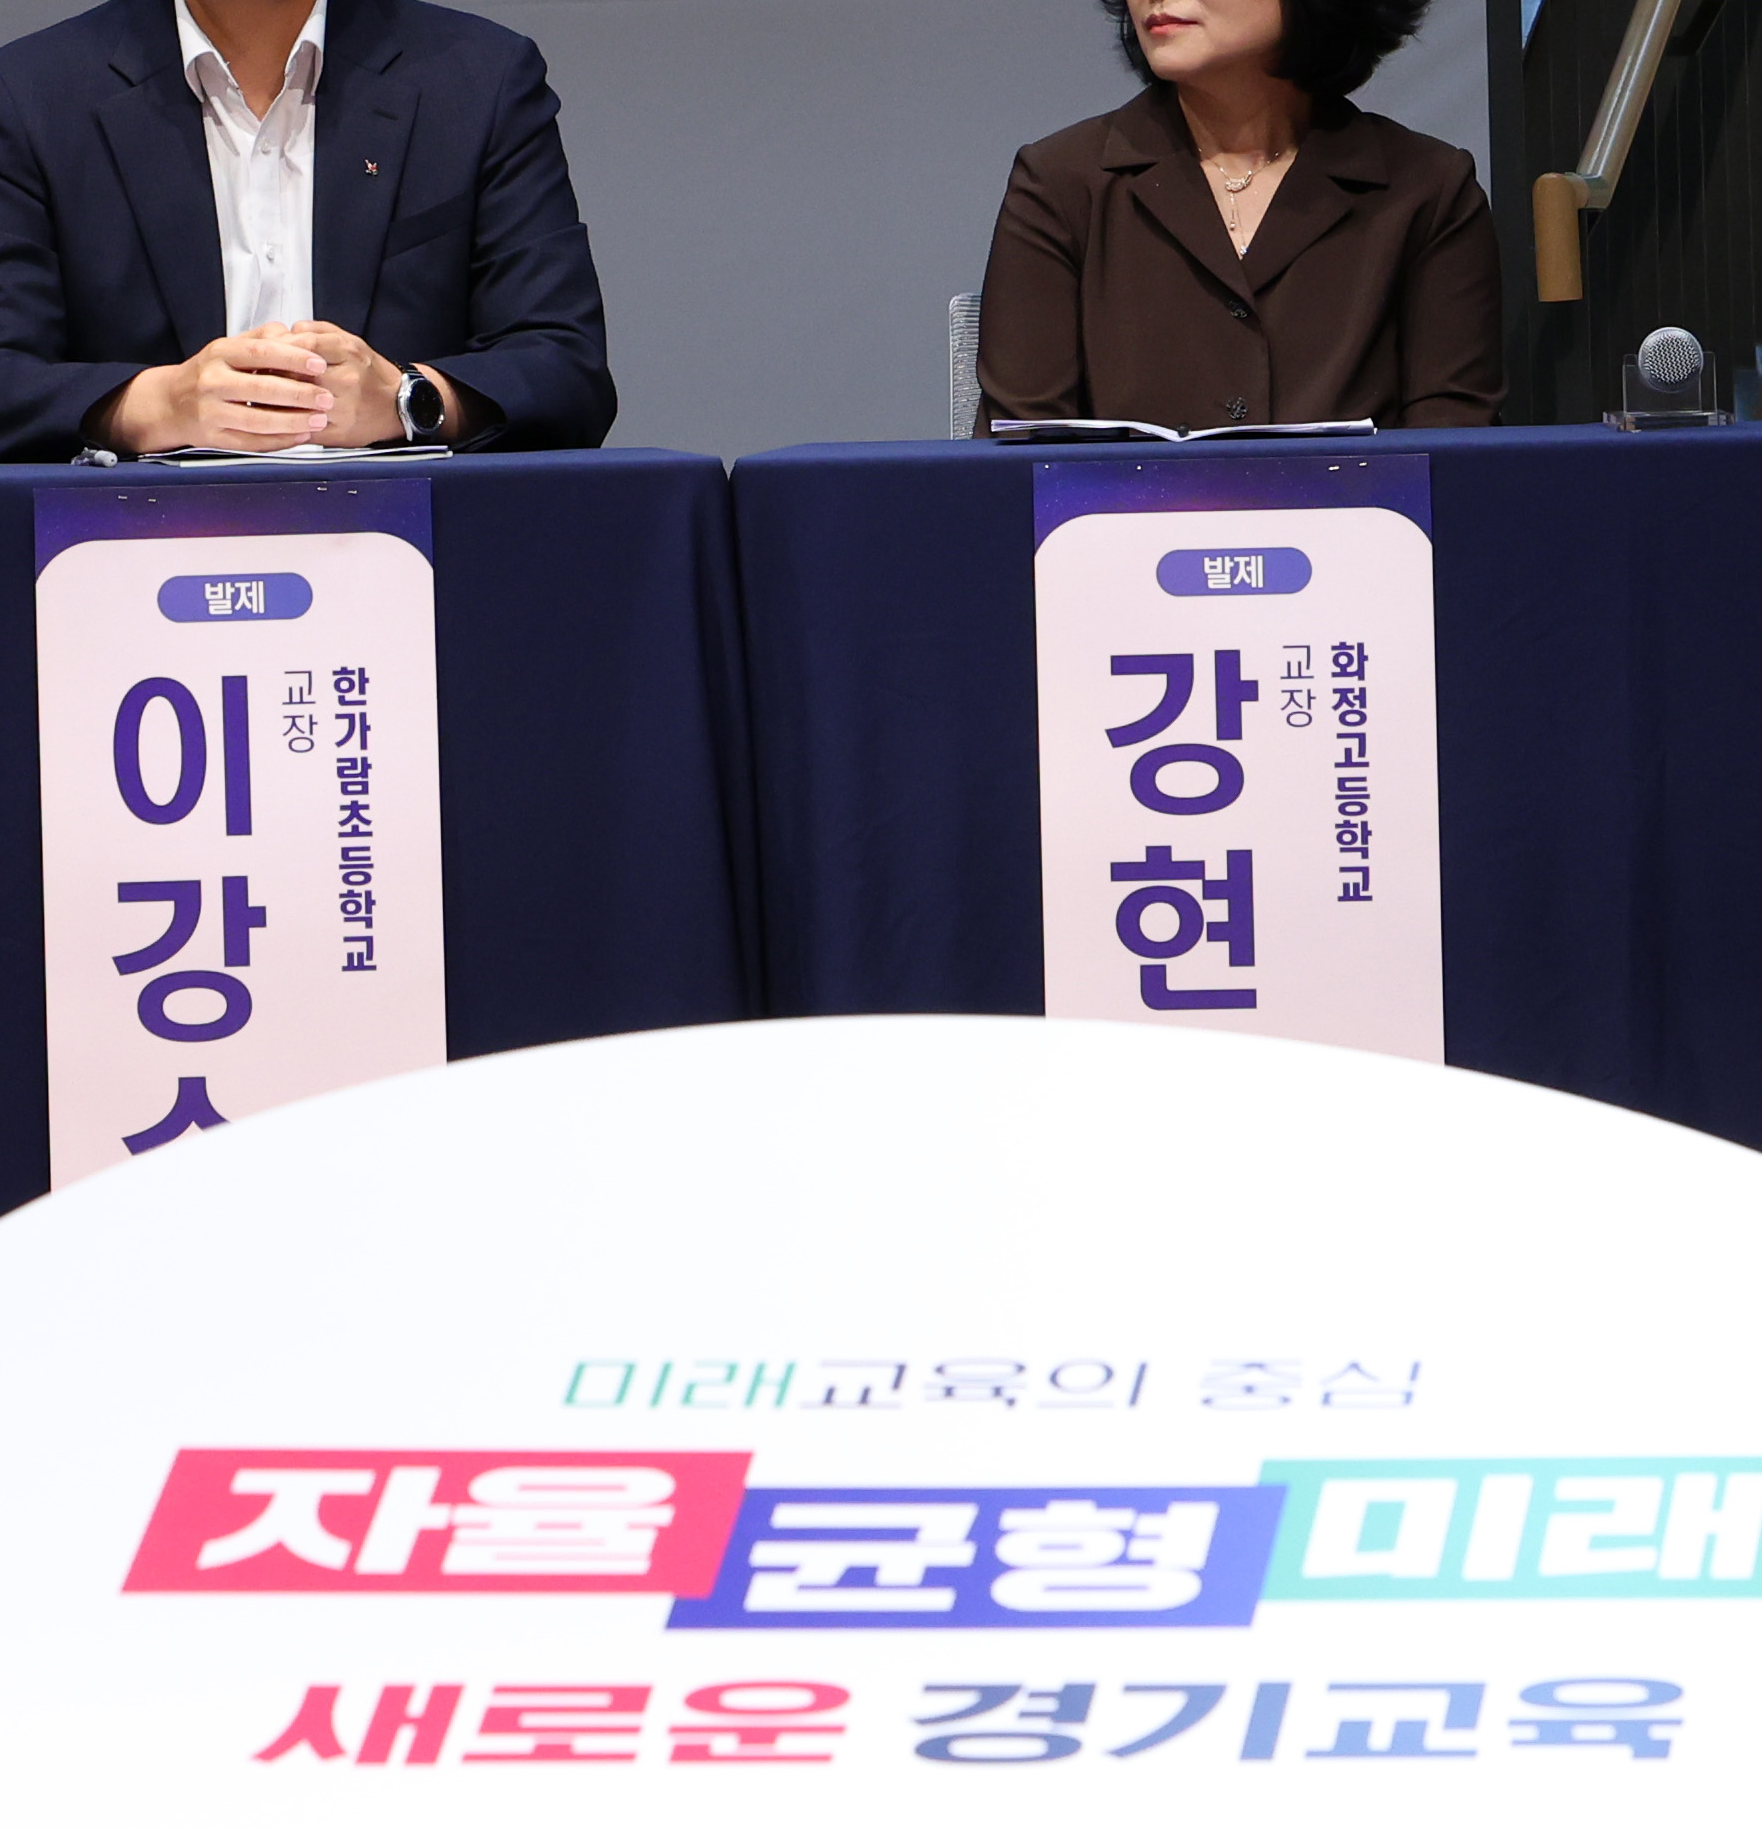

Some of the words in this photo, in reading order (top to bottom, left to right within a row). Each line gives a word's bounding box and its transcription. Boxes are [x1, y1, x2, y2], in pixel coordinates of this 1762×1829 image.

[204, 580, 265, 615] 발제
[1203, 556, 1263, 589] 발제
[282, 669, 318, 754] 교장
[1279, 644, 1316, 728] 교장
[1330, 641, 1373, 902] 화정고등학교
[332, 666, 377, 972] 한가람초등학교
[560, 1358, 1151, 1411] 미래교육의
[1195, 1358, 1423, 1410] 중심
[194, 1465, 677, 1578] 자율
[742, 1500, 1220, 1616] 균형
[249, 1679, 853, 1767] 새로운
[910, 1676, 1689, 1765] 경기교육
